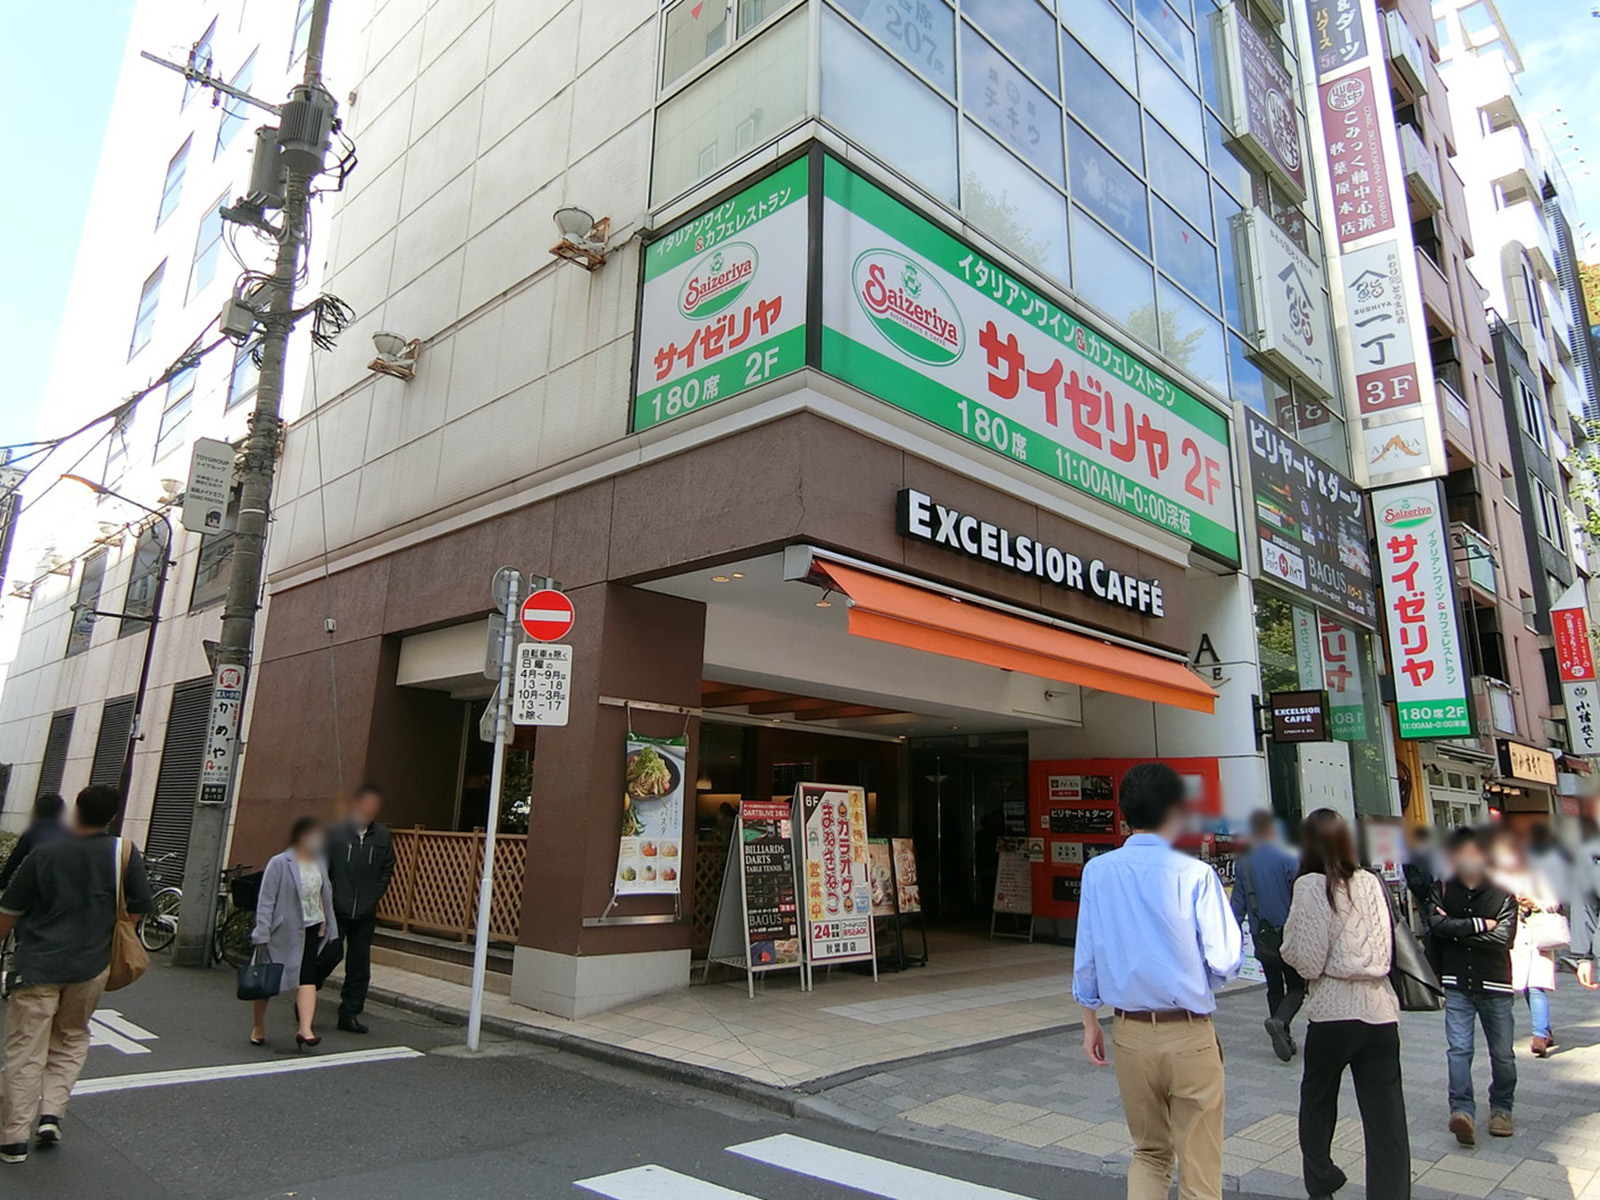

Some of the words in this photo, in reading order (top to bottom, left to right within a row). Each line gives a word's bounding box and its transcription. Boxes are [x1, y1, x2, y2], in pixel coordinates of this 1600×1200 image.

[1330, 142, 1356, 236] 秋葉原本店
[1343, 111, 1376, 232] こみっく軸中心派
[656, 200, 736, 256] イタリアンワイン
[683, 259, 752, 311] Saizeriya
[863, 263, 958, 343] Saizeriya
[1353, 301, 1392, 316] SUSHIYA
[654, 295, 782, 382] サイゼリヤ
[1355, 313, 1396, 366] 一丁
[652, 375, 720, 422] 180席
[744, 347, 780, 387] 2F
[1366, 374, 1413, 406] 3F
[957, 400, 1028, 461] 180席
[978, 320, 1169, 480] サイゼリヤ
[1181, 437, 1221, 506] 2F
[1249, 418, 1362, 518] ビリヤード&ダーツ
[908, 489, 1084, 591] EXCELSIOR
[1384, 505, 1433, 524] Saizeriya
[1308, 554, 1346, 594] BAGUS
[1387, 533, 1435, 687] サイゼリヤ
[522, 649, 568, 659] 自転車を除く
[522, 659, 553, 669] 日曜の
[519, 710, 543, 721] を除く
[1274, 706, 1321, 717] EXCELSIOR
[1445, 705, 1466, 719] 2F
[805, 795, 819, 808] 6F
[744, 844, 785, 855] BILLIARDS
[745, 855, 772, 865] DARTS
[746, 865, 762, 873] TABLE
[763, 864, 783, 873] TENNIS
[821, 802, 840, 913] まねきねこ
[838, 819, 853, 896] カラオケ
[814, 924, 831, 940] 24
